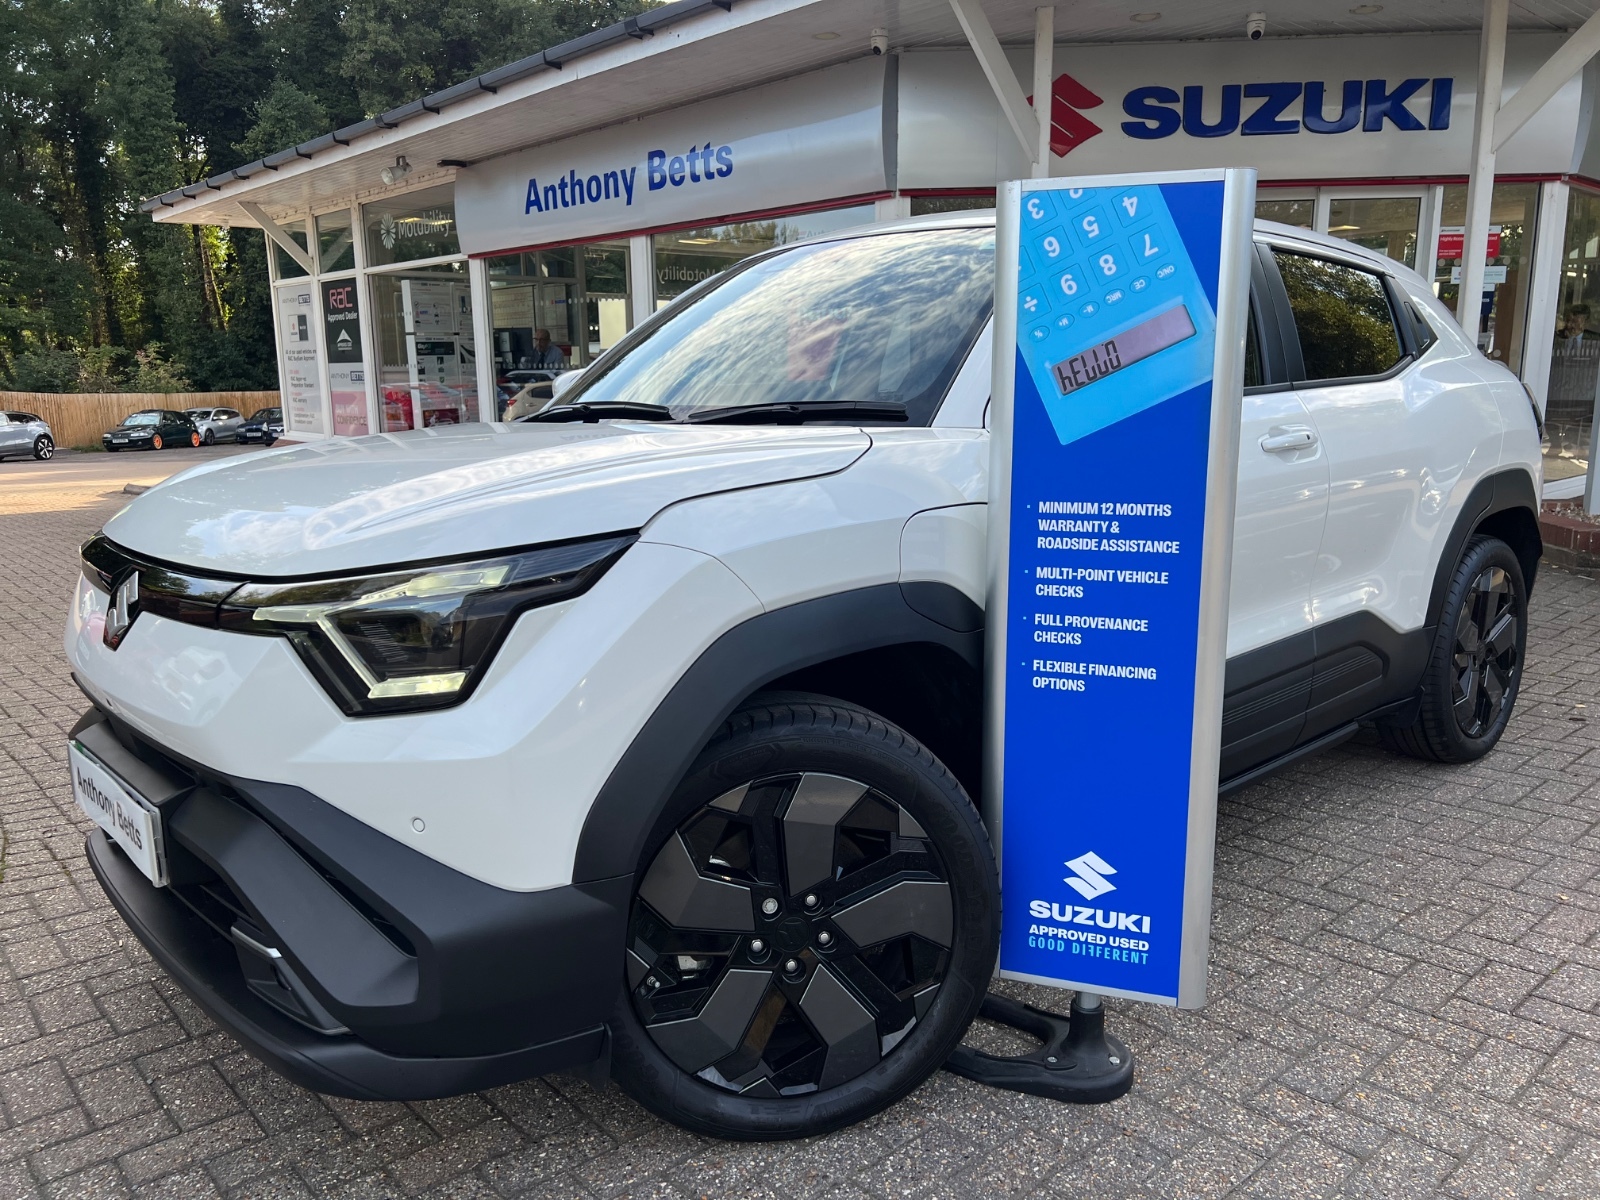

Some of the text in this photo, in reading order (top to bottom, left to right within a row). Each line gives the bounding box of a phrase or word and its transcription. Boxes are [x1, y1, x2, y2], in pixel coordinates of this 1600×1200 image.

[1120, 77, 1454, 140] SUZUKI
[524, 141, 733, 215] Anthony Betts
[1027, 198, 1044, 219] 3
[1122, 196, 1138, 217] 4
[398, 209, 452, 240] Motability
[1082, 216, 1099, 238] 5
[1099, 254, 1117, 276] 8
[328, 311, 358, 323] Approved Dealer
[1038, 501, 1172, 517] MINIMUM 12 MONTHS
[1038, 519, 1120, 534] WARRANTY &
[1037, 537, 1180, 554] ROADSIDE ASSISTANCE
[1036, 567, 1169, 584] MULTI-POINT VEHICLE
[1035, 584, 1084, 598] CHECKS
[1034, 613, 1148, 632] FULL PROVENANCE
[1033, 631, 1082, 645] CHECKS
[1033, 659, 1157, 680] FLEXIBLE FINANCING
[1032, 676, 1085, 692] OPTIONS
[77, 767, 143, 850] Anthony Betts
[1029, 900, 1151, 934] SUZUKI
[1029, 924, 1149, 951] APPROVED USED
[1028, 936, 1149, 965] GOOD DIFFERENT
